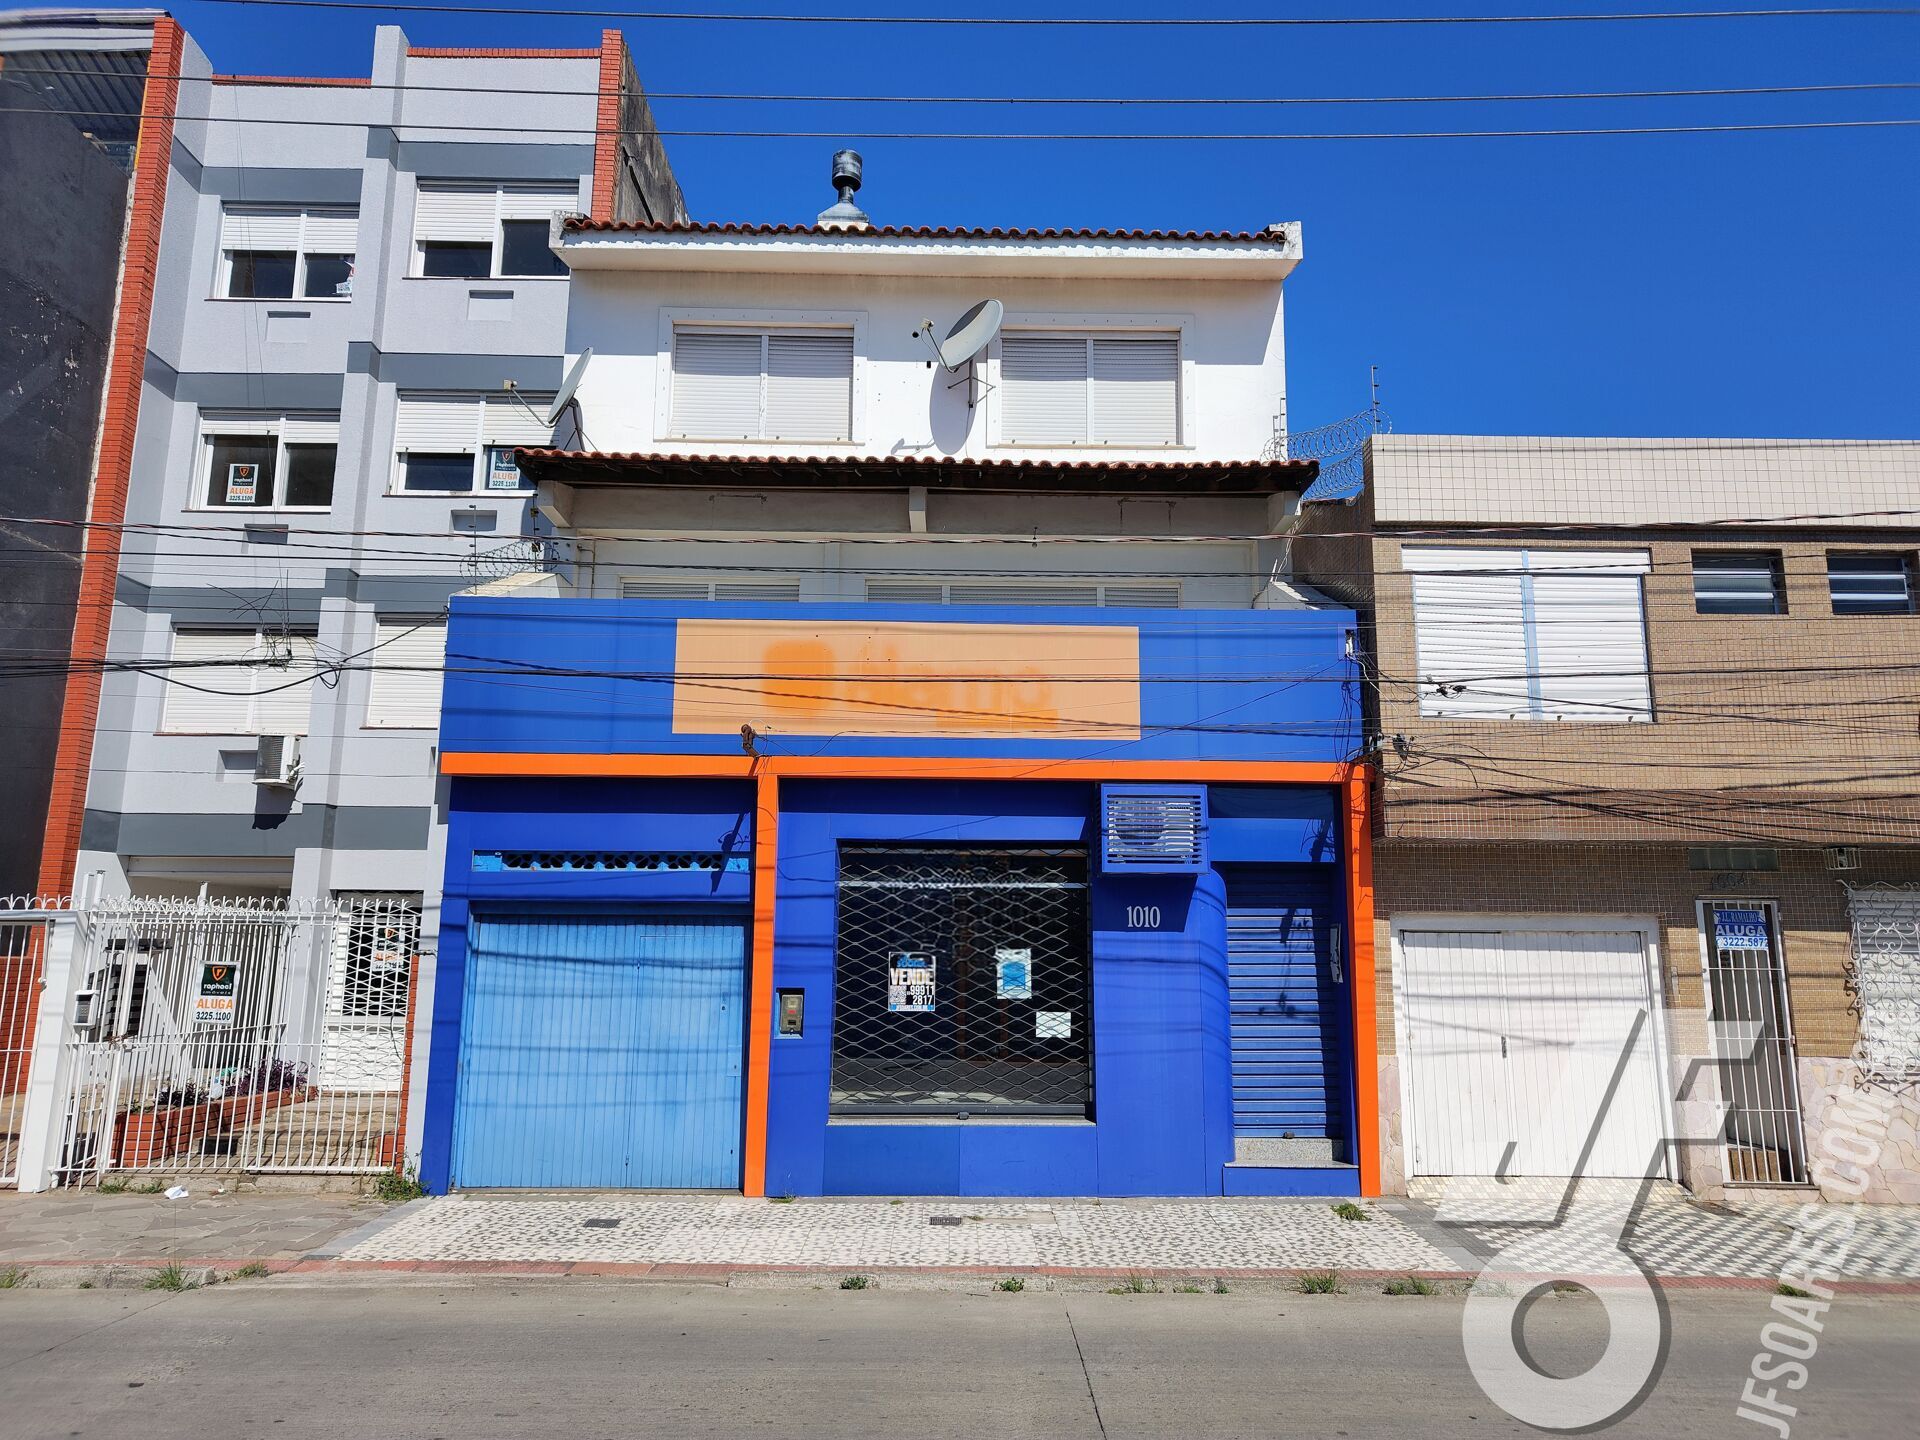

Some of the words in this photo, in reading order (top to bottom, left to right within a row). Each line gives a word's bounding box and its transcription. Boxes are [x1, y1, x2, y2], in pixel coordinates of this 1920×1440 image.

[492, 472, 517, 480] ALUGA
[230, 487, 254, 495] ALUGA
[1126, 905, 1161, 928] 1010
[1715, 924, 1766, 936] ALUGA
[890, 967, 935, 986] VENDE
[203, 982, 233, 991] raphael
[910, 985, 935, 996] 99911
[196, 998, 233, 1009] ALUGA
[912, 995, 933, 1005] 2817
[195, 1011, 232, 1021] 3225.1100
